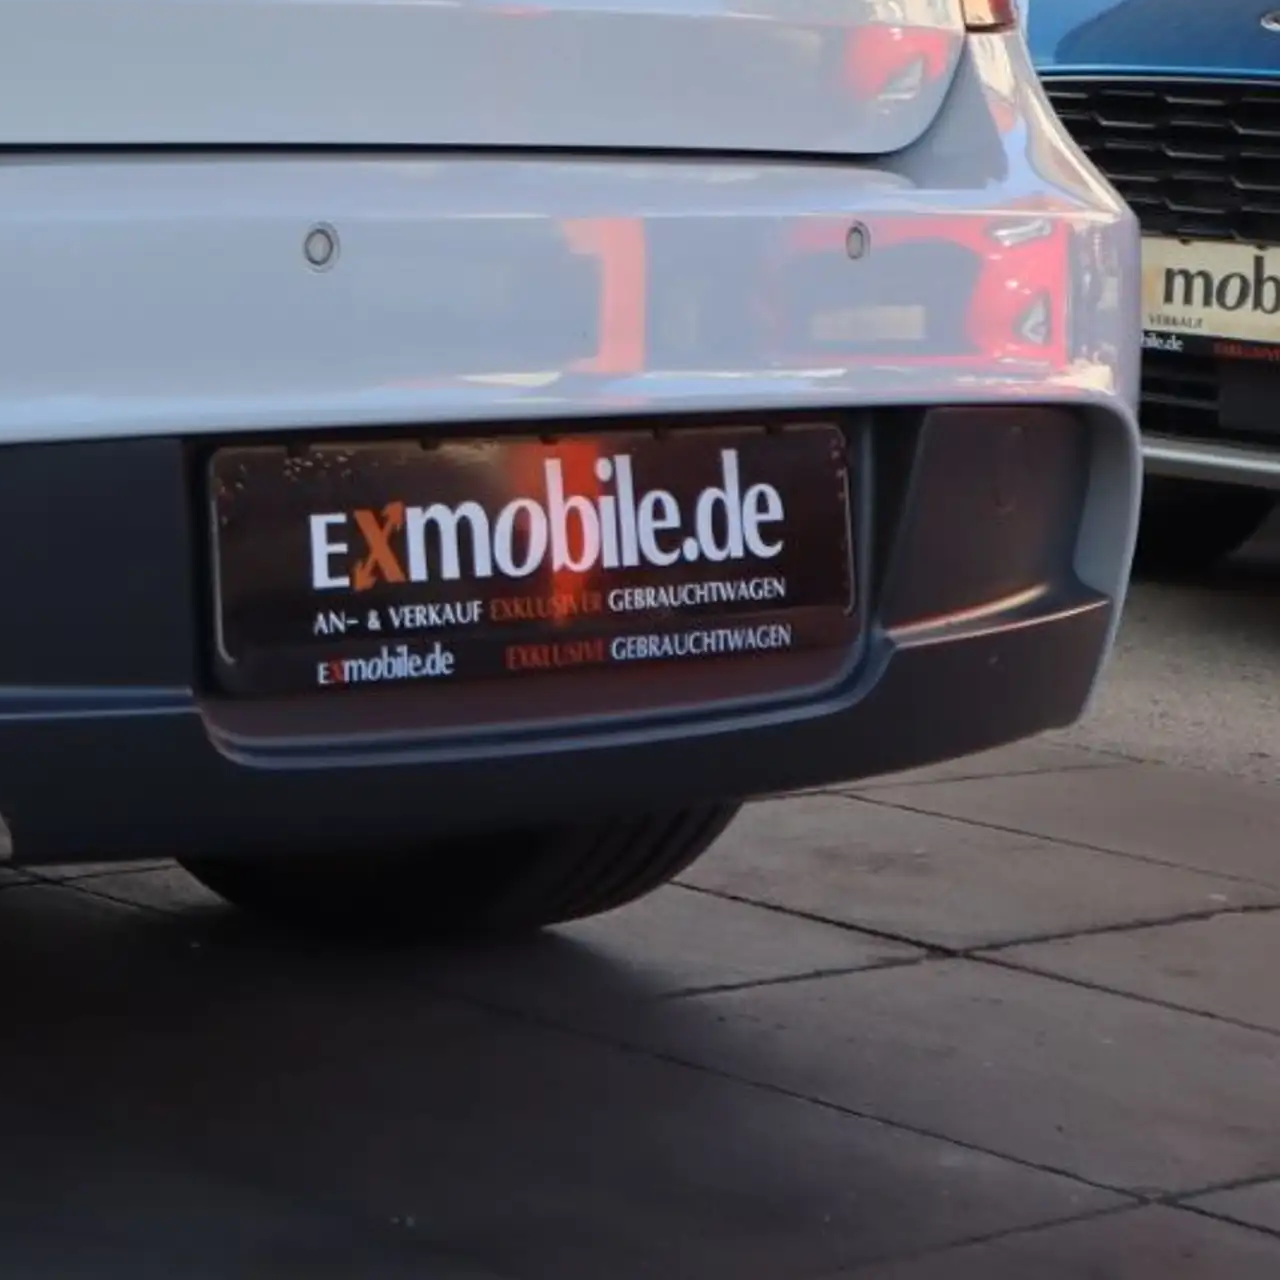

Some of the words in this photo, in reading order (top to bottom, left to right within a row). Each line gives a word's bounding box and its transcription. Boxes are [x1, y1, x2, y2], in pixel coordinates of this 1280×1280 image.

[367, 609, 382, 631] &
[388, 600, 484, 629] VERKAUF
[608, 576, 786, 612] GEBRAUCHTWAGEN
[611, 623, 792, 660] GEBRAUCHTWAGEN
